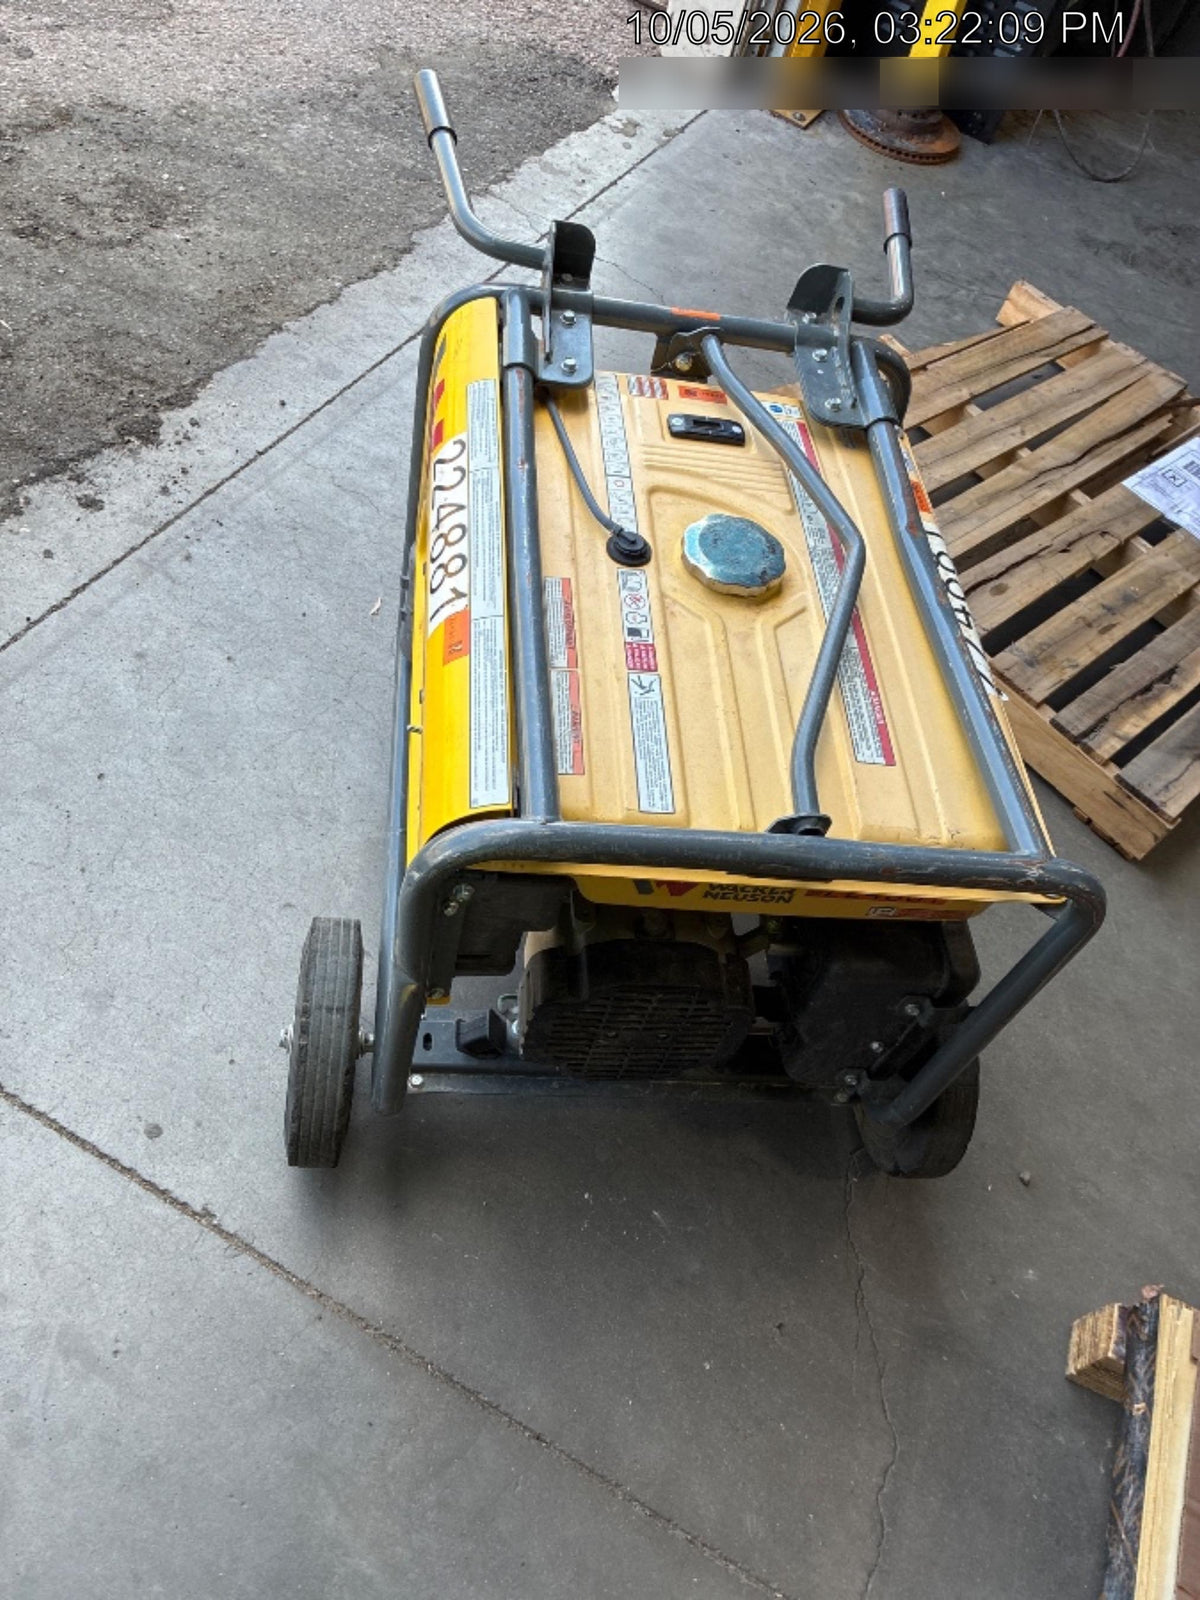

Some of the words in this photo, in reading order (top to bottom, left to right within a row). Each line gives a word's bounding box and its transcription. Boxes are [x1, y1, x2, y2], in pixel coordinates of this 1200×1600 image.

[430, 438, 468, 622] 224881
[709, 884, 797, 895] WACKER
[702, 891, 794, 904] NEUSON
